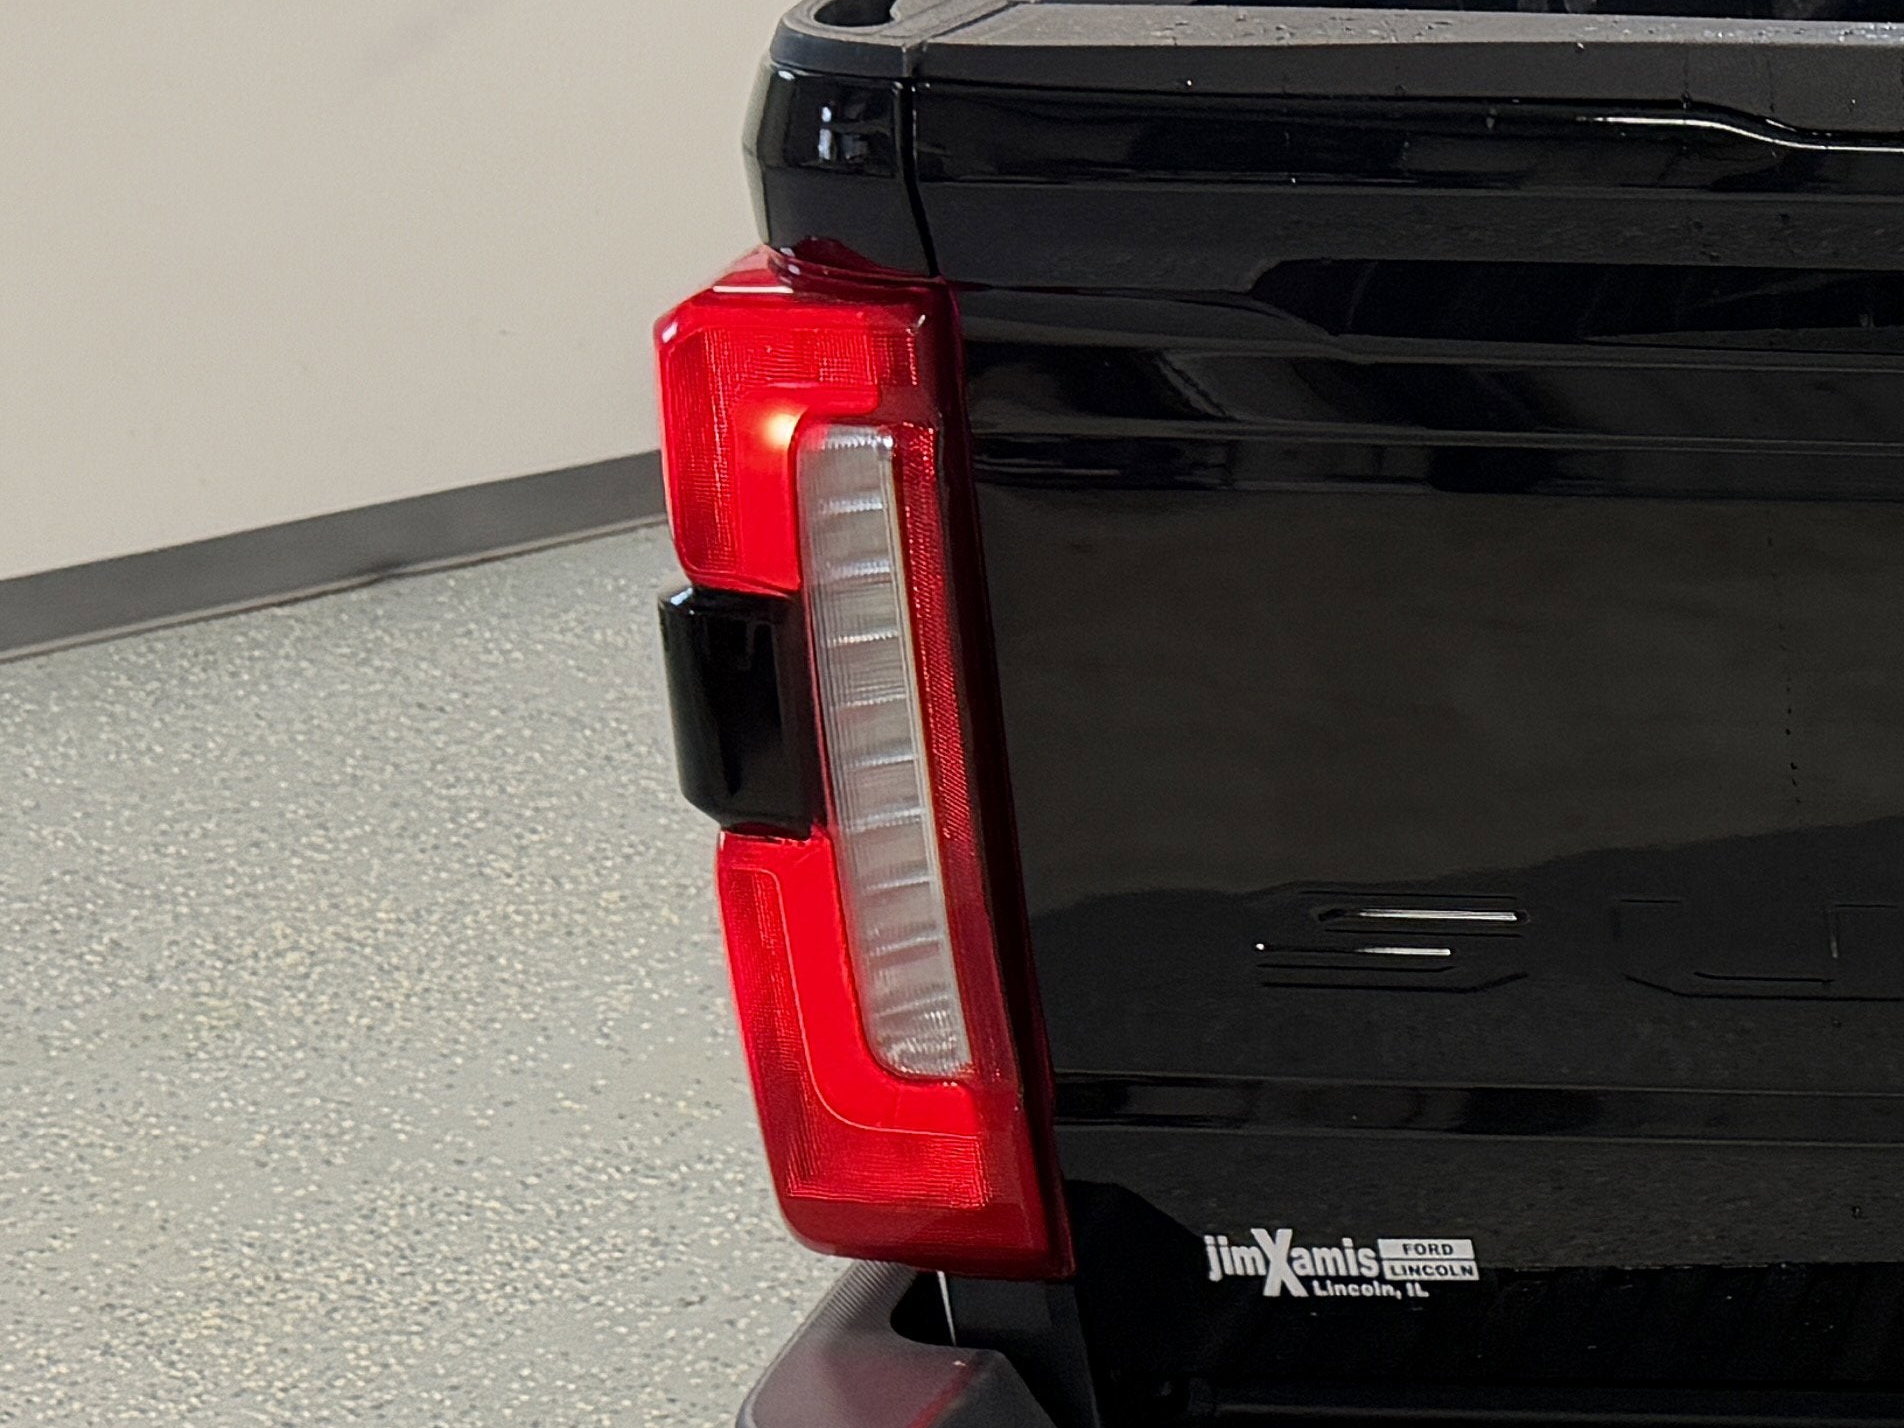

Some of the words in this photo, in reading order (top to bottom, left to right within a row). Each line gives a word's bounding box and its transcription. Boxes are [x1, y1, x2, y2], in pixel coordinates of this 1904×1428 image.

[1402, 1243, 1454, 1256] FORD
[1389, 1264, 1474, 1277] LINCOLN
[1313, 1280, 1402, 1300] Lincoln,
[1405, 1281, 1430, 1298] IL
